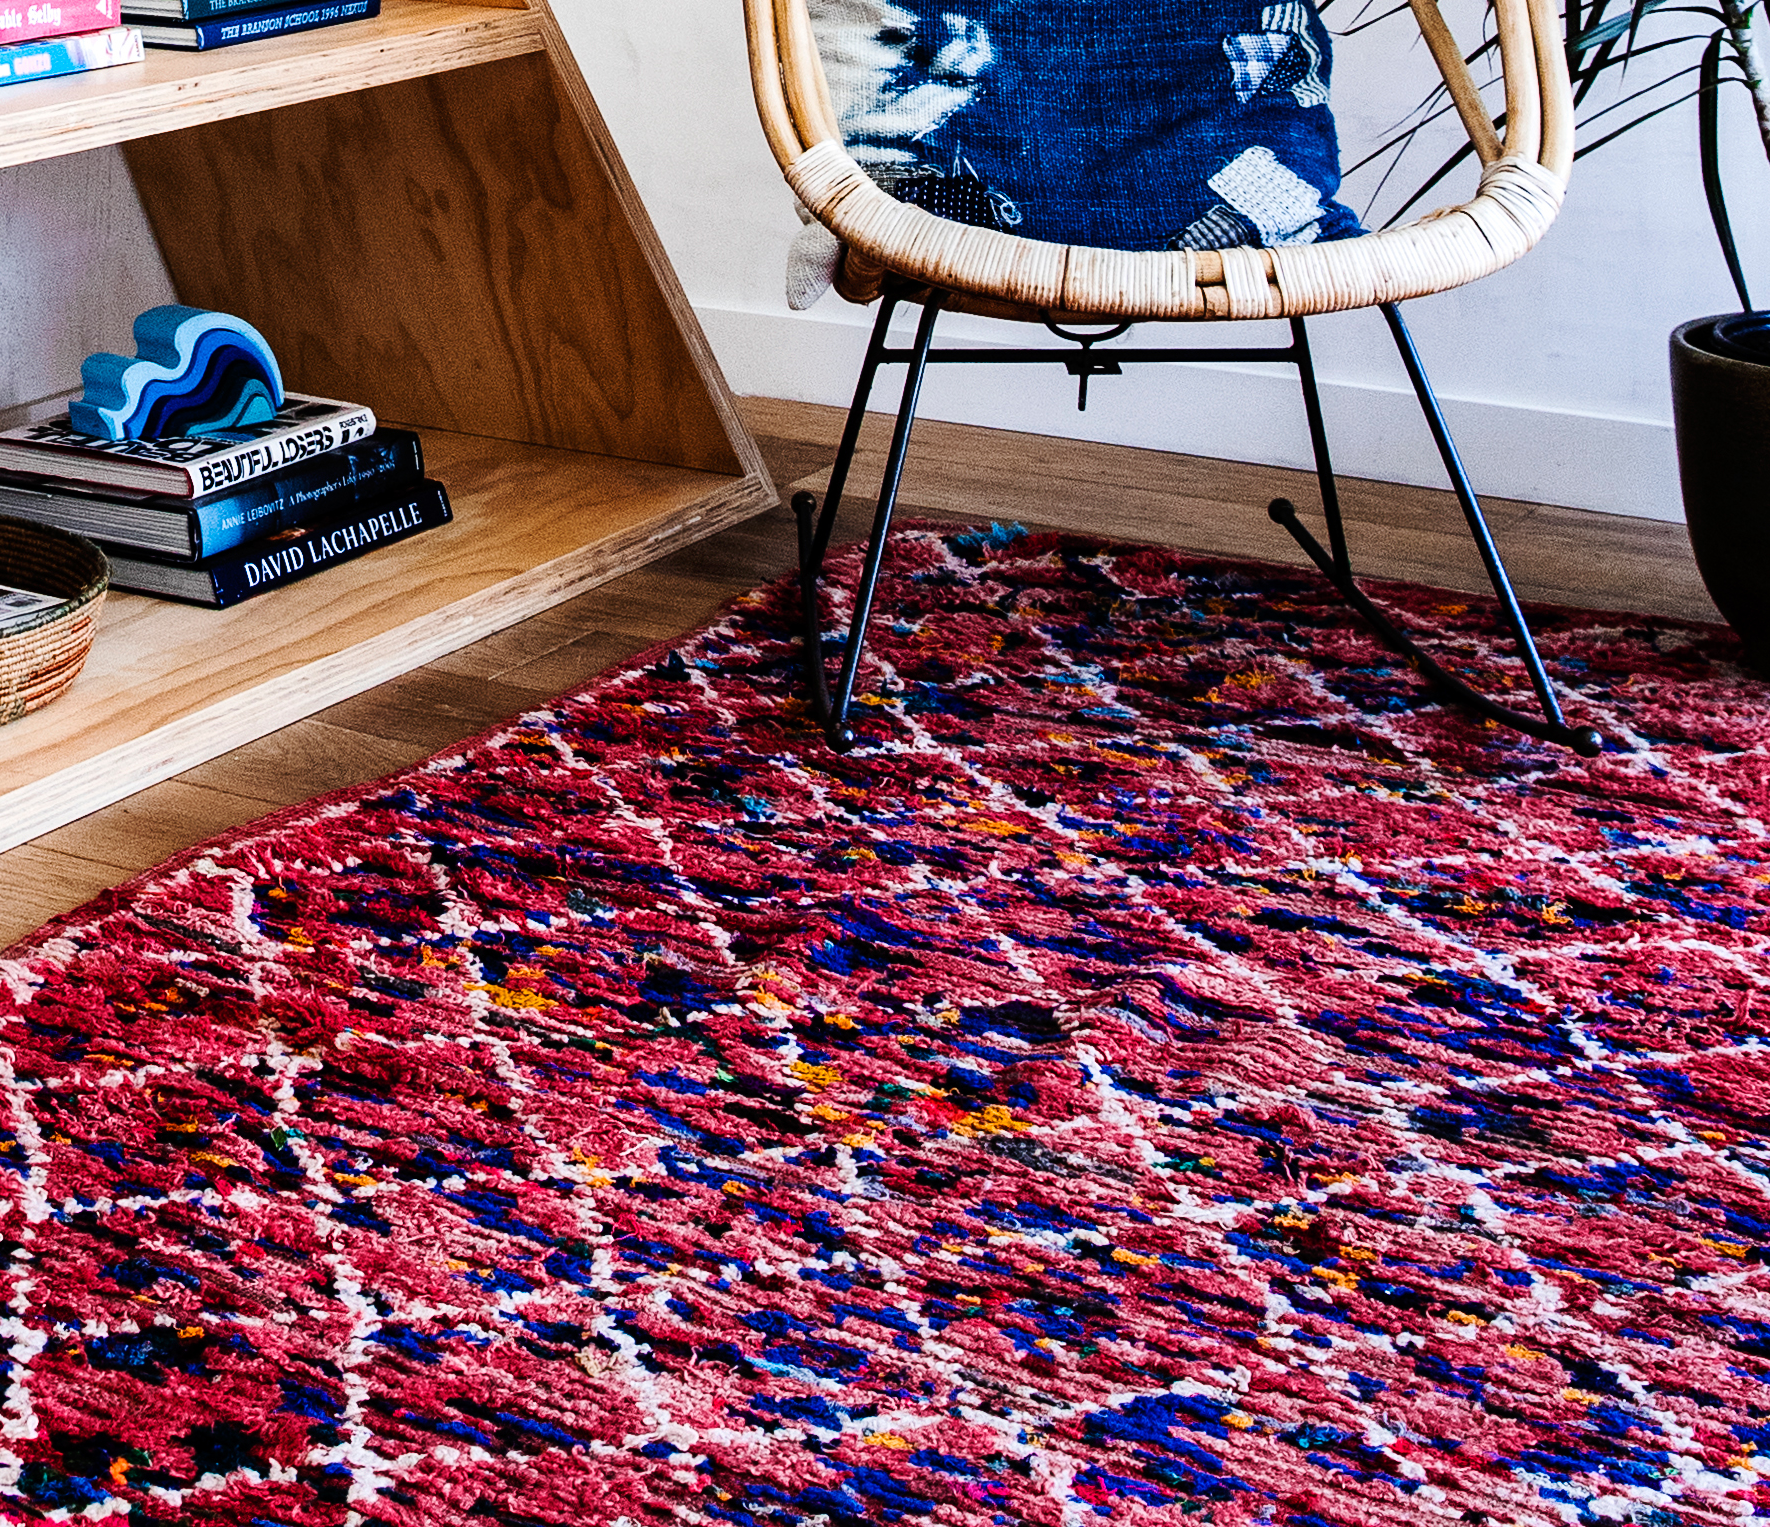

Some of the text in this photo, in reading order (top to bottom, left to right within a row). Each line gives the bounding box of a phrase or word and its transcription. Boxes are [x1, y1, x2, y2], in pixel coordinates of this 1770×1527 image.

[27, 2, 62, 27] Selby
[209, 0, 227, 11] THE
[220, 24, 240, 40] THE
[240, 16, 283, 37] BRANSON
[284, 10, 320, 29] SCHOOL
[340, 0, 369, 17] NEXUS
[199, 445, 280, 492] BEAUTIFUL
[279, 425, 335, 466] LOSERS
[288, 494, 296, 507] A
[294, 476, 342, 506] Photographer's
[221, 498, 285, 532] ANNIE LEIBOVITZ
[243, 545, 305, 588] DAVID
[307, 502, 423, 565] LACHAPELLE
